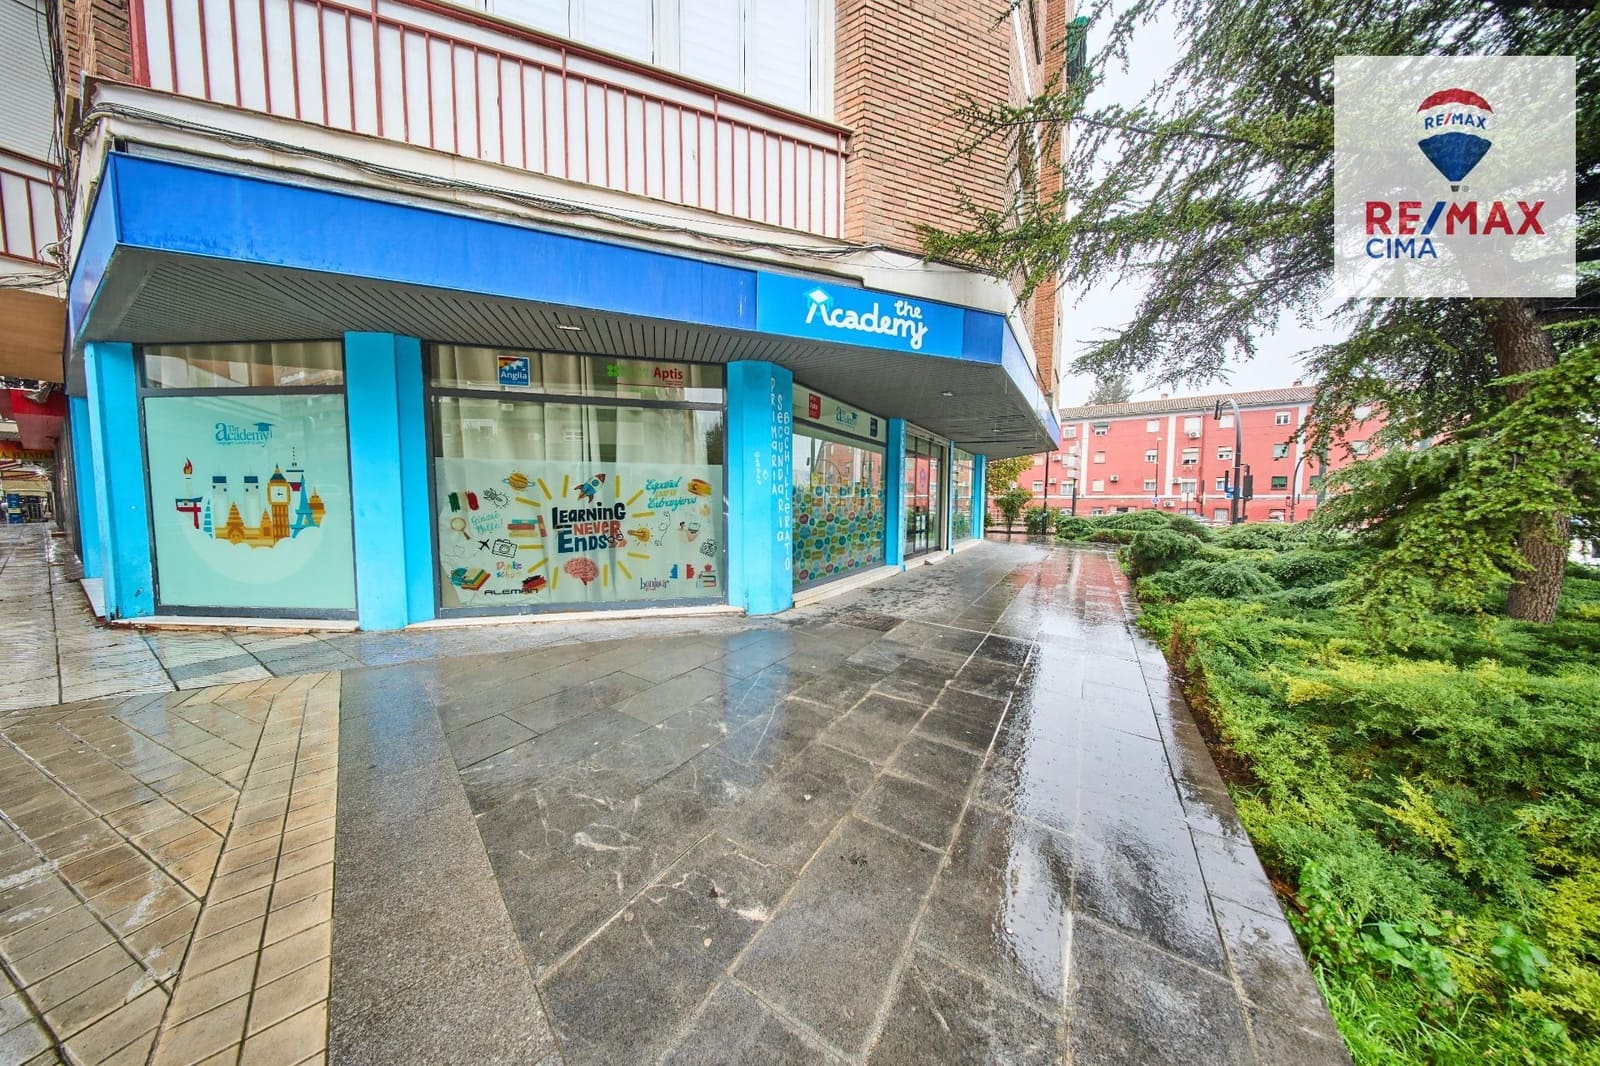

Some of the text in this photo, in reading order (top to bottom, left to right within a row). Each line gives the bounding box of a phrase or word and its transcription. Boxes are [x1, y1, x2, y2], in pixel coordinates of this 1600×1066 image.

[894, 300, 923, 319] the
[805, 289, 928, 350] Academy
[500, 370, 528, 381] Anglia
[653, 367, 683, 381] Aptis
